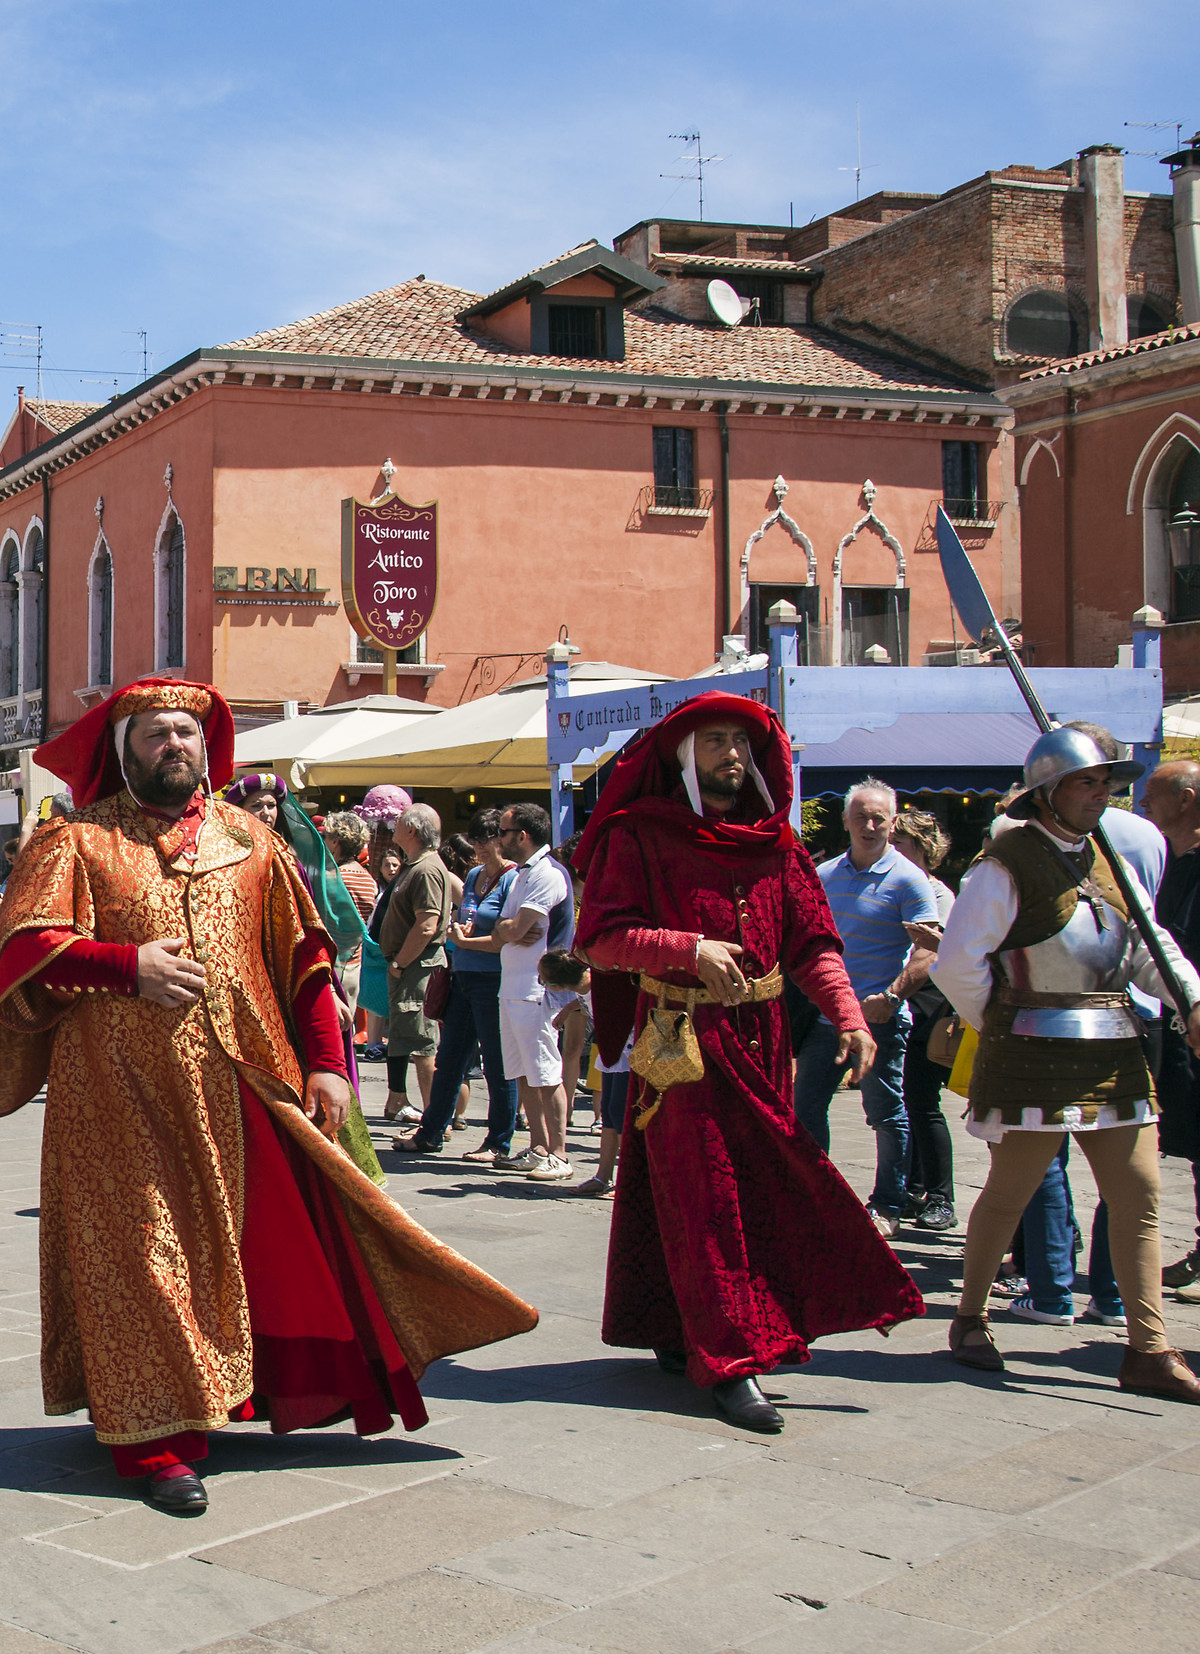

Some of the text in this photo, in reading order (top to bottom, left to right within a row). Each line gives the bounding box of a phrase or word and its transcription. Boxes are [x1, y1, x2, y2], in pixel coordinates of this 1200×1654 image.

[360, 523, 430, 544] Ristorante
[368, 550, 423, 572] Antico
[246, 567, 331, 592] BNL
[373, 580, 417, 604] Toro
[575, 701, 641, 731] Contrada
